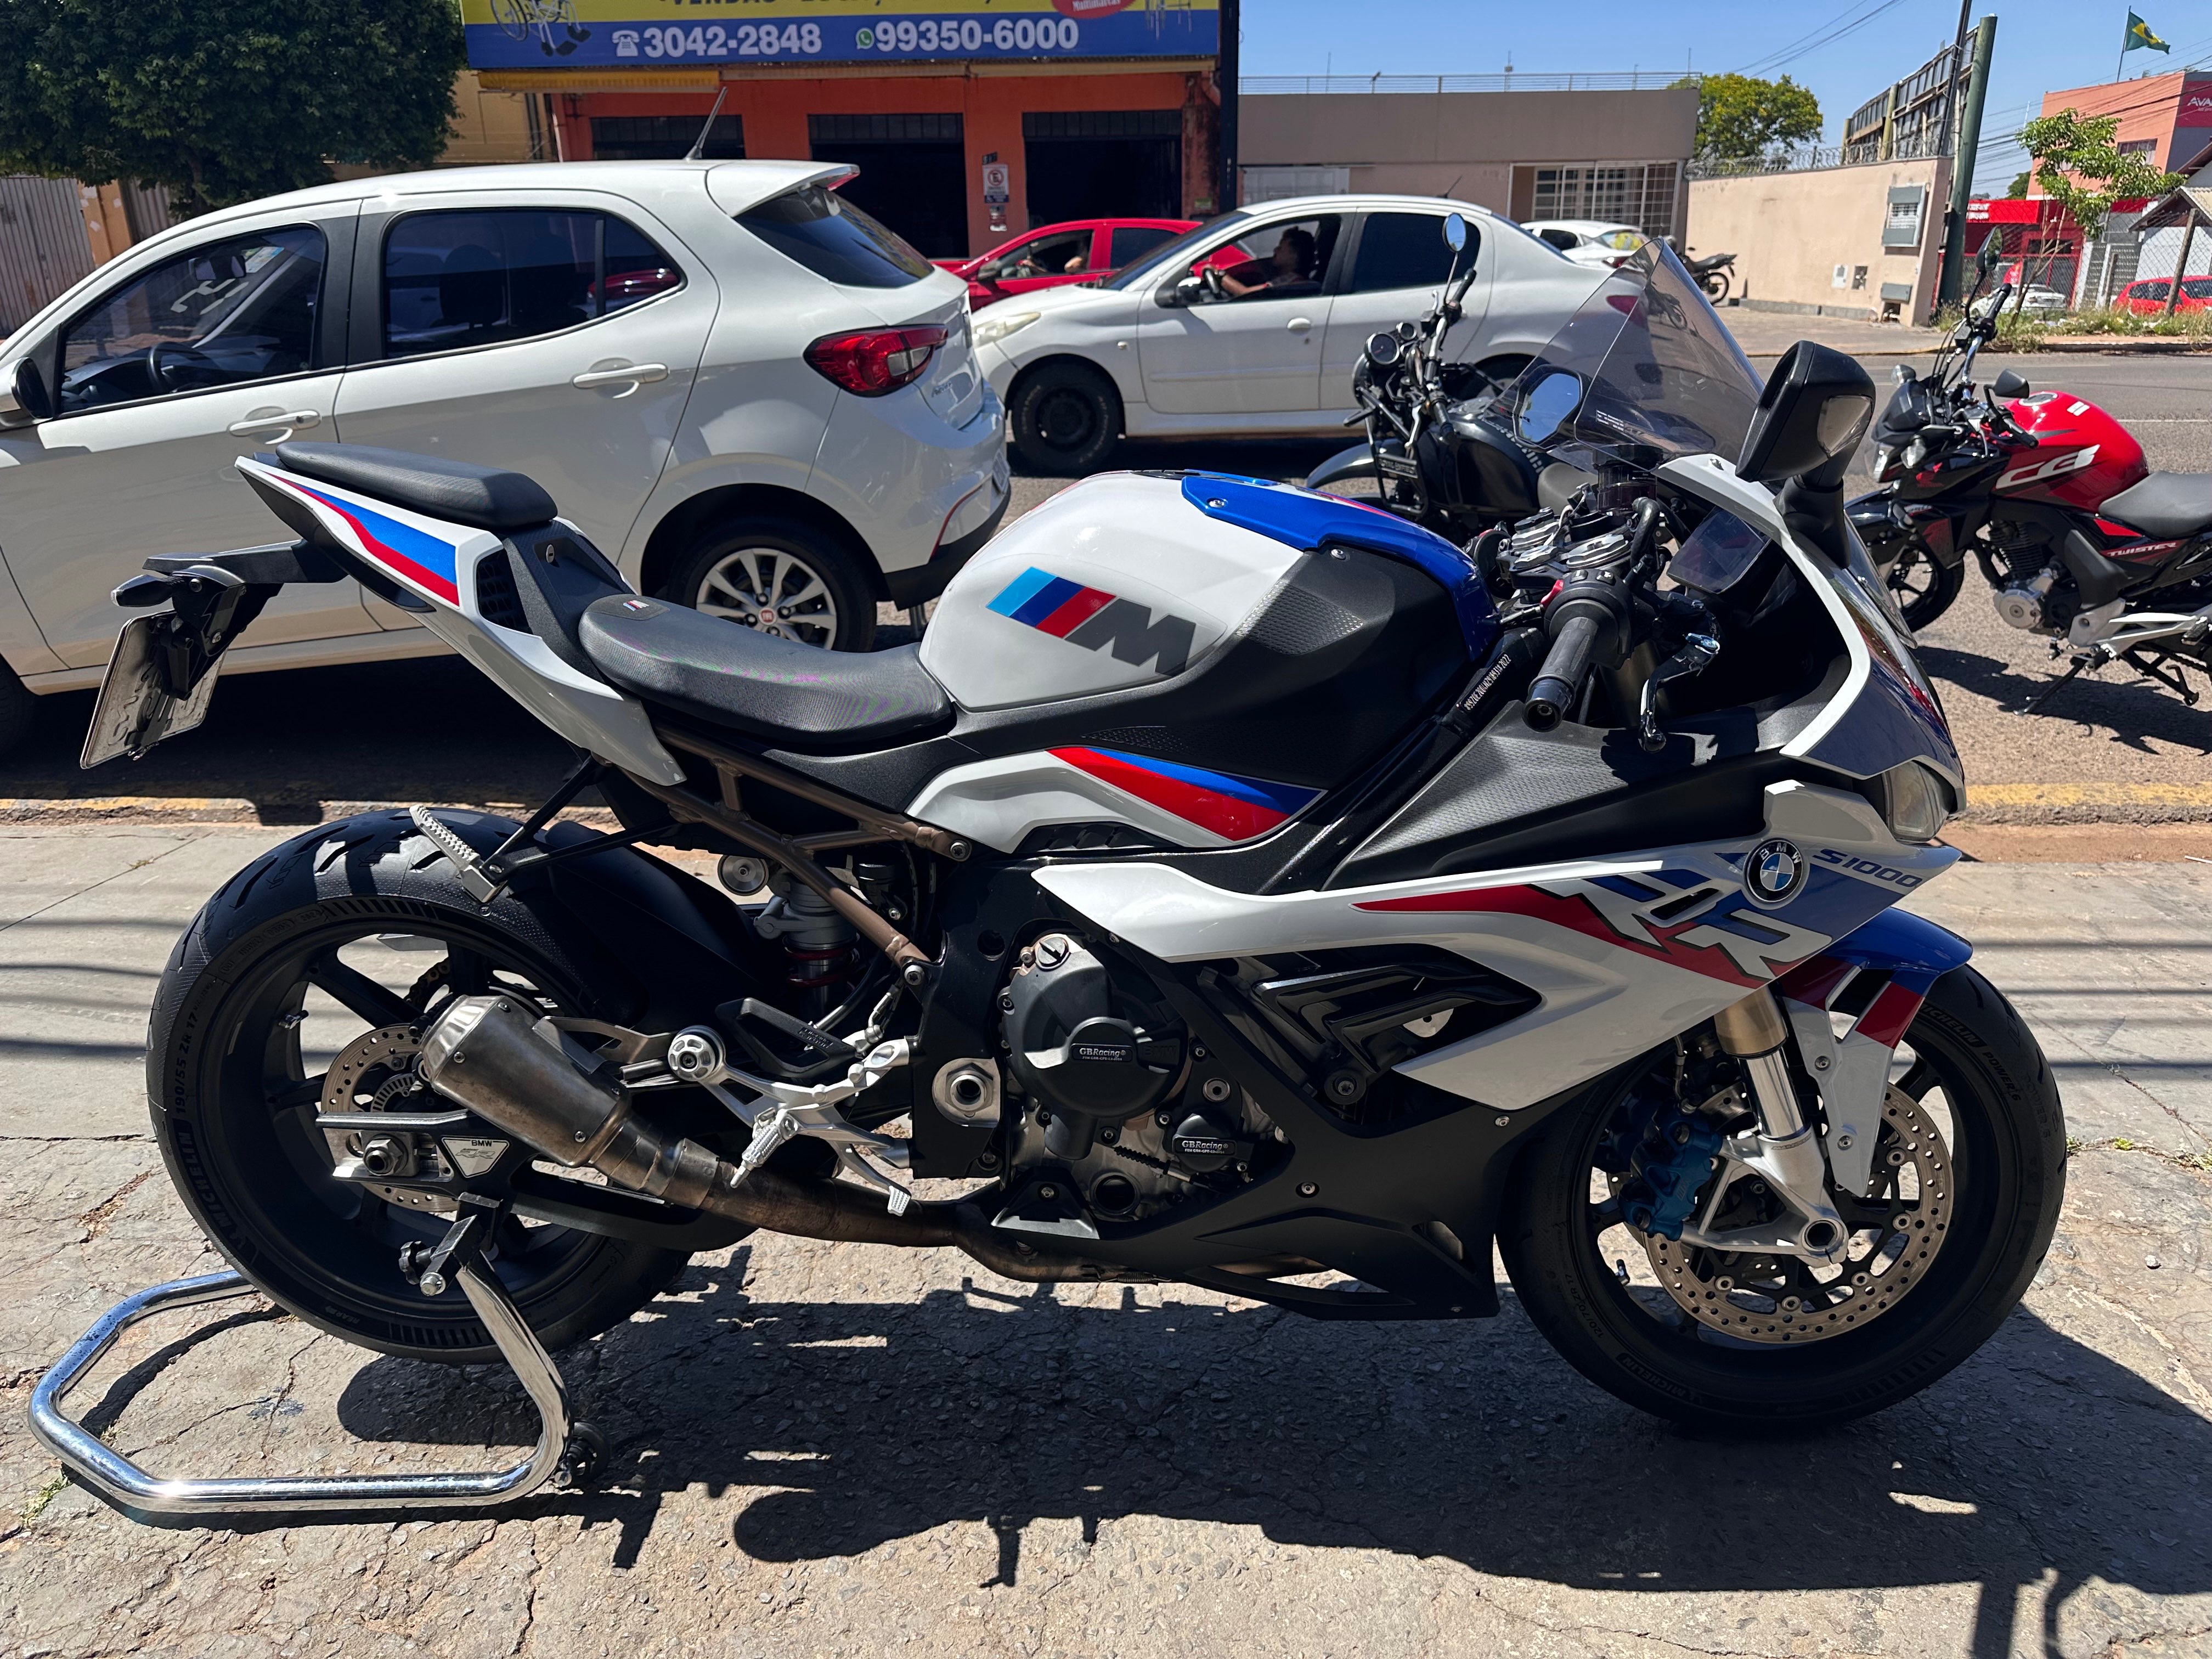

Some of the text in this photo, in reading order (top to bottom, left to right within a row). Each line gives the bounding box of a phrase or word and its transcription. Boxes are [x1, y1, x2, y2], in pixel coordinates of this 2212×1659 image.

[643, 23, 822, 58] 3042-2848
[876, 18, 1080, 52] 99350-6000
[2107, 542, 2177, 557] TWISTER
[1812, 848, 1923, 889] S1000
[1920, 1006, 1980, 1047] ICHELIN
[173, 1012, 199, 1114] 190/55 ZR 17
[1982, 1052, 2022, 1102] POWER 6
[176, 1132, 232, 1227] MICHELIN
[1579, 1305, 1604, 1340] 120/70
[1622, 1356, 1688, 1398] MICHELIN
